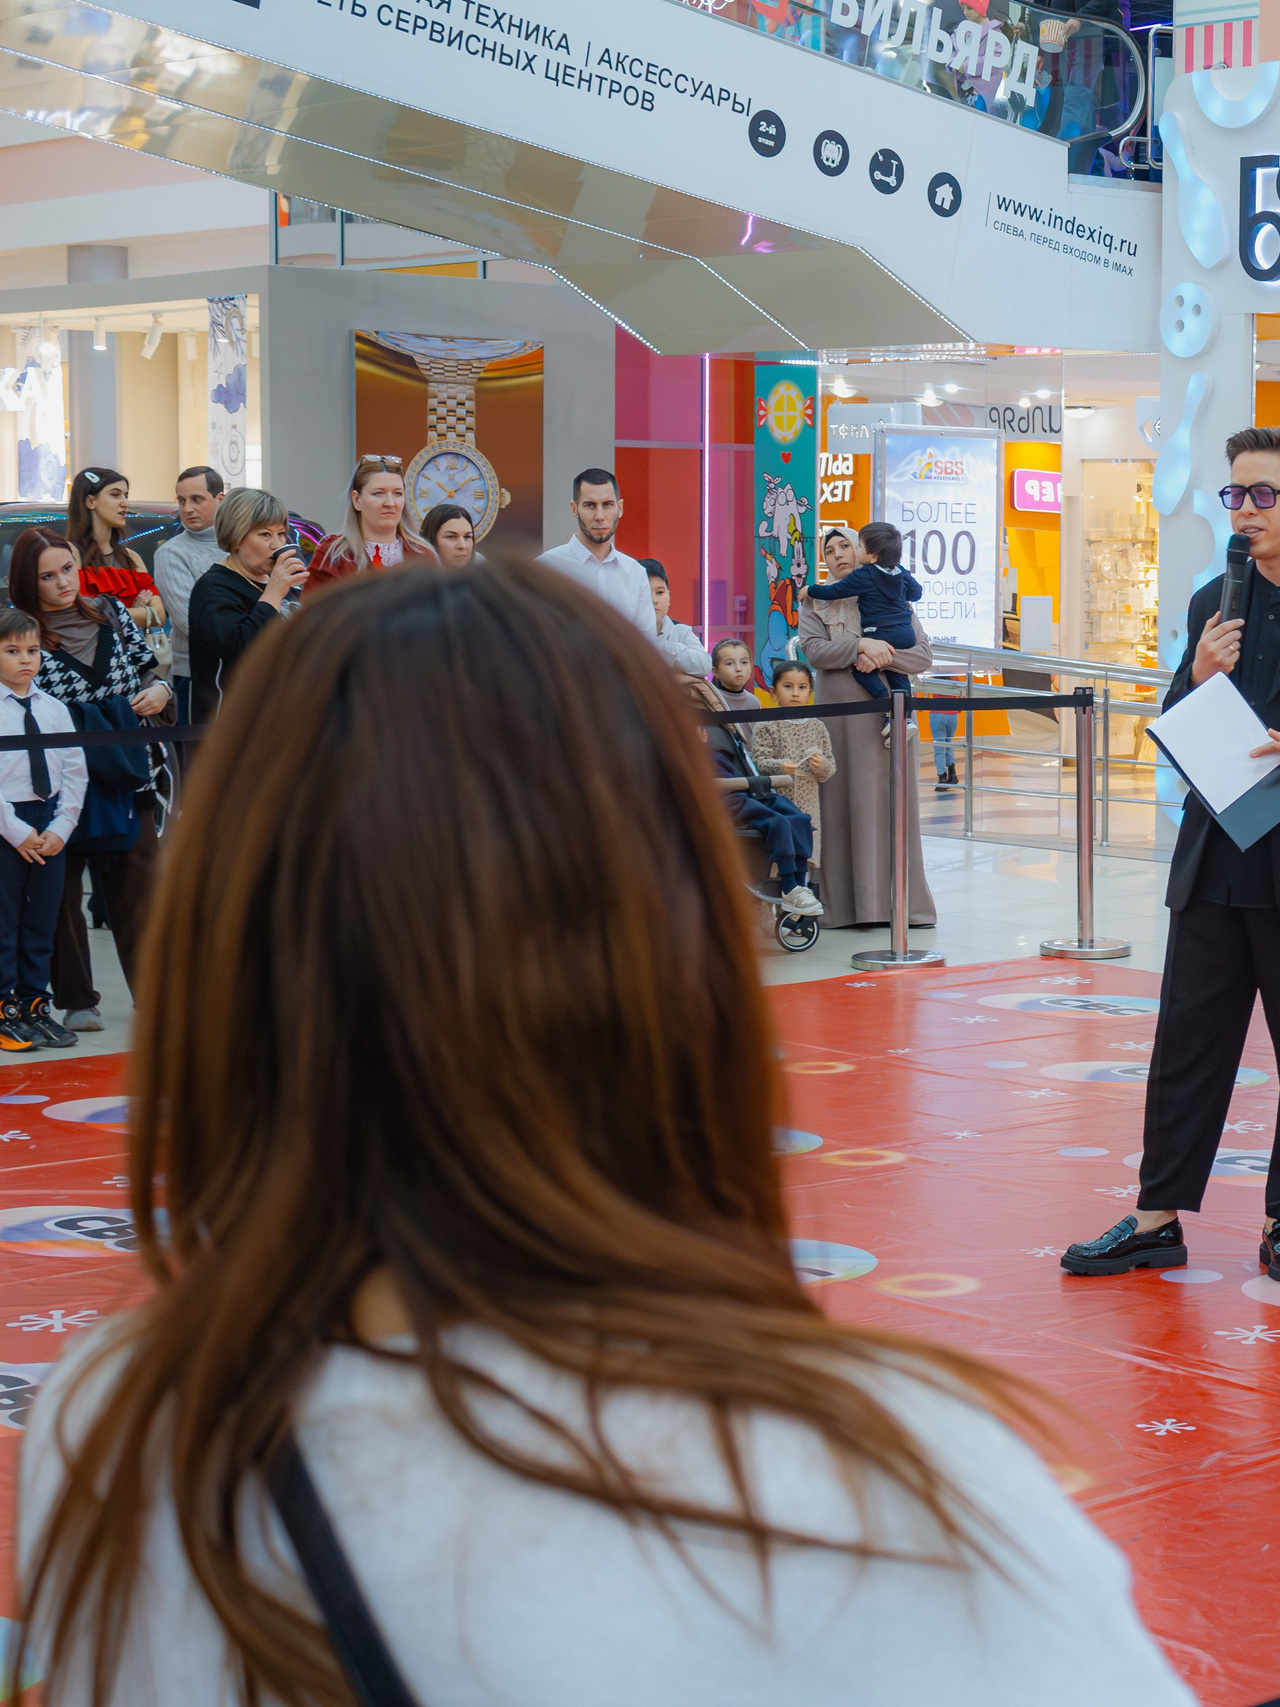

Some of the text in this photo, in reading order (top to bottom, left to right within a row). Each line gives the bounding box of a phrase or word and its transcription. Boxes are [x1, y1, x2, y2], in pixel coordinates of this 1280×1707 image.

[376, 3, 537, 76] СЕРВИСНЫХ
[544, 58, 656, 112] ЦЕНТРОВ
[460, 0, 571, 56] ТЕХНИКА
[597, 47, 752, 117] АКСЕССУАРЫ
[992, 219, 1134, 277] СЛЕВА, ПЕРЕД ВХОДОМ В IMAX
[996, 194, 1138, 258] www.indexiq.ru
[933, 459, 965, 477] SBS
[901, 501, 977, 524] БОЛЕЕ
[901, 529, 976, 576] 100
[915, 601, 976, 620] ЕБЕЛИ
[922, 580, 978, 596] ЛОНОВ
